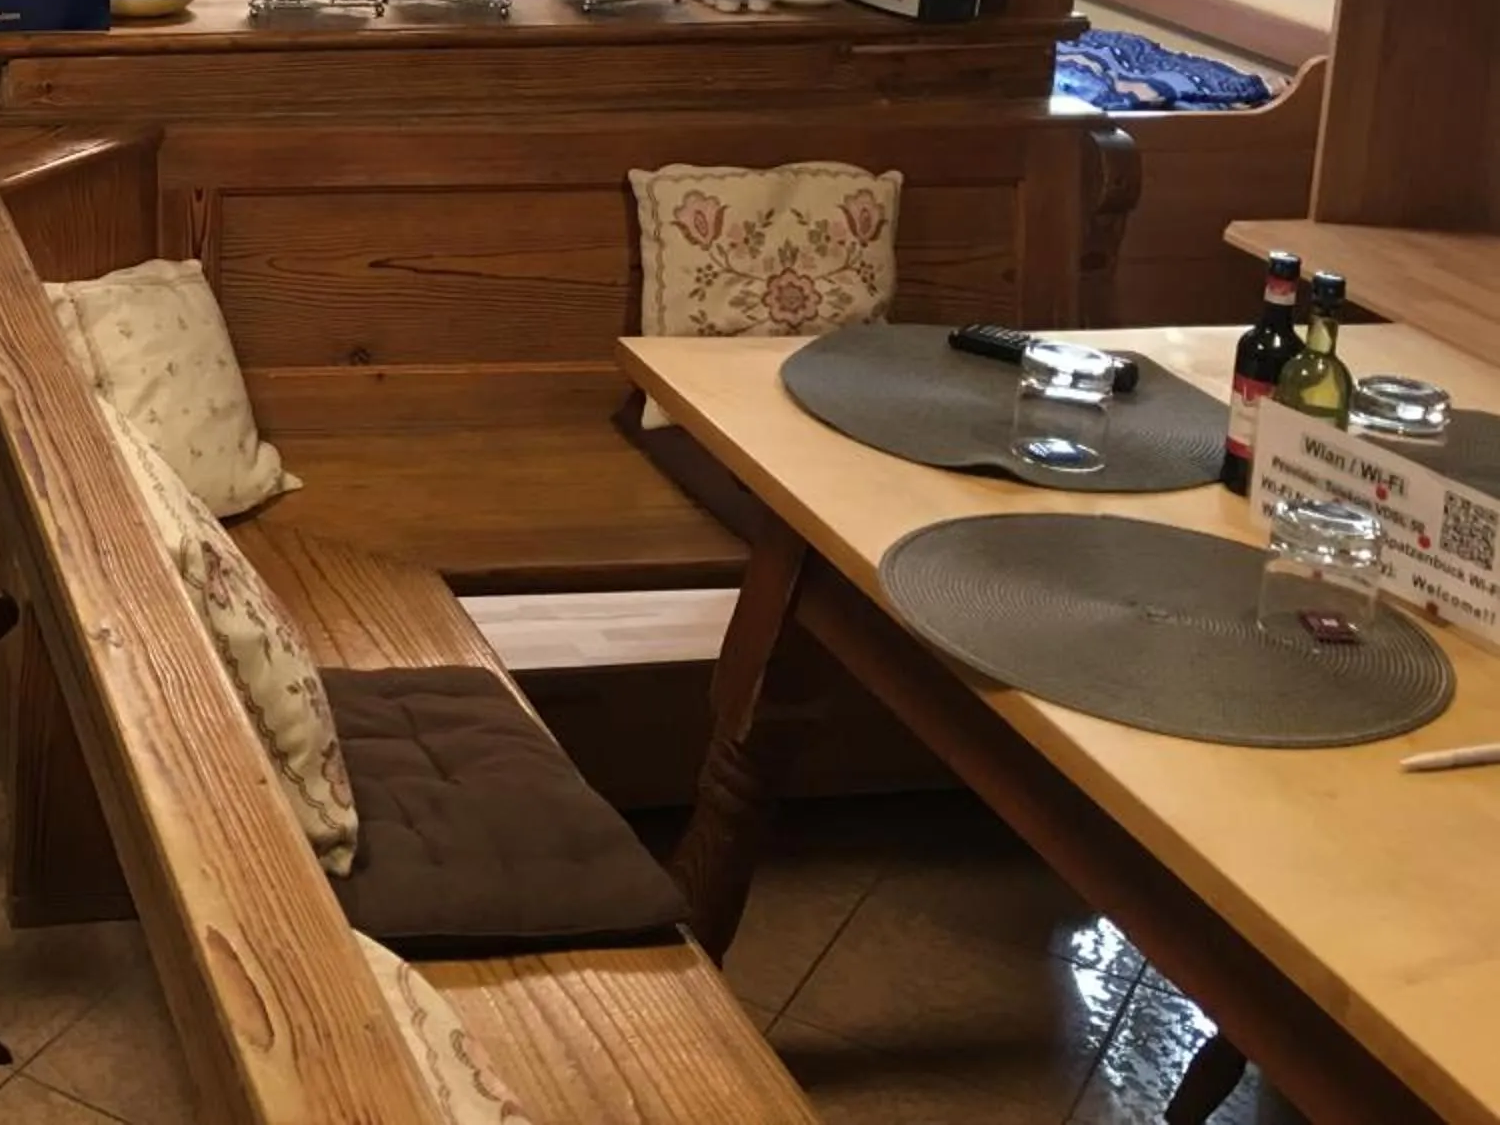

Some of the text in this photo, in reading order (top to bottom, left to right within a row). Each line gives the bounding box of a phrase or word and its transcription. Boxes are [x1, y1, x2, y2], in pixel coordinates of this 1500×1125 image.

[1304, 435, 1346, 472] Wlan
[1360, 460, 1405, 496] Wi-Fi
[1411, 572, 1496, 626] Welcome!!
[1468, 572, 1500, 598] Wi-F
